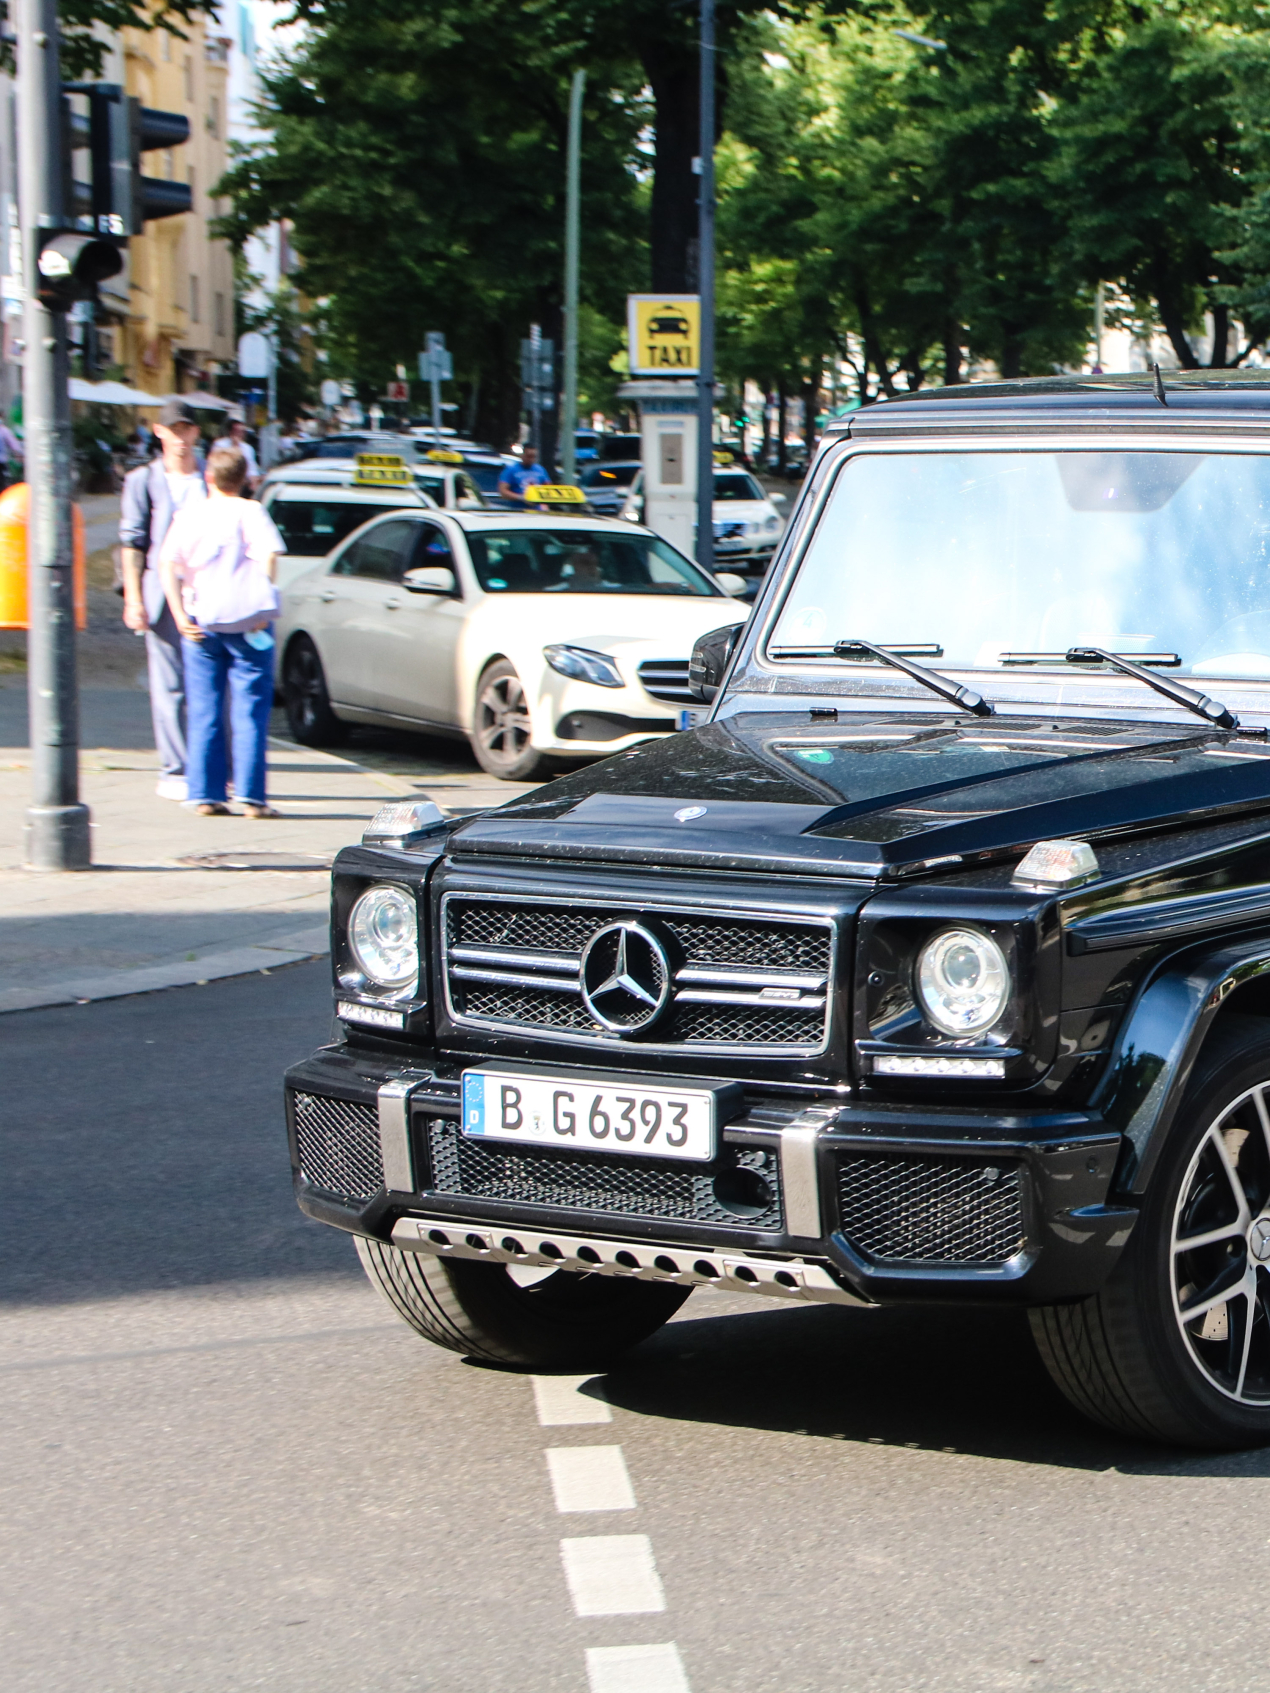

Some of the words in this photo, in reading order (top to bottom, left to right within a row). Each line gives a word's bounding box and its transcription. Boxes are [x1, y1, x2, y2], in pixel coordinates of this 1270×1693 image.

[647, 346, 692, 366] TAXI
[537, 487, 578, 500] TAXI
[470, 1109, 479, 1124] D
[501, 1085, 523, 1130] B
[553, 1090, 576, 1136] G
[589, 1094, 688, 1147] 6393
